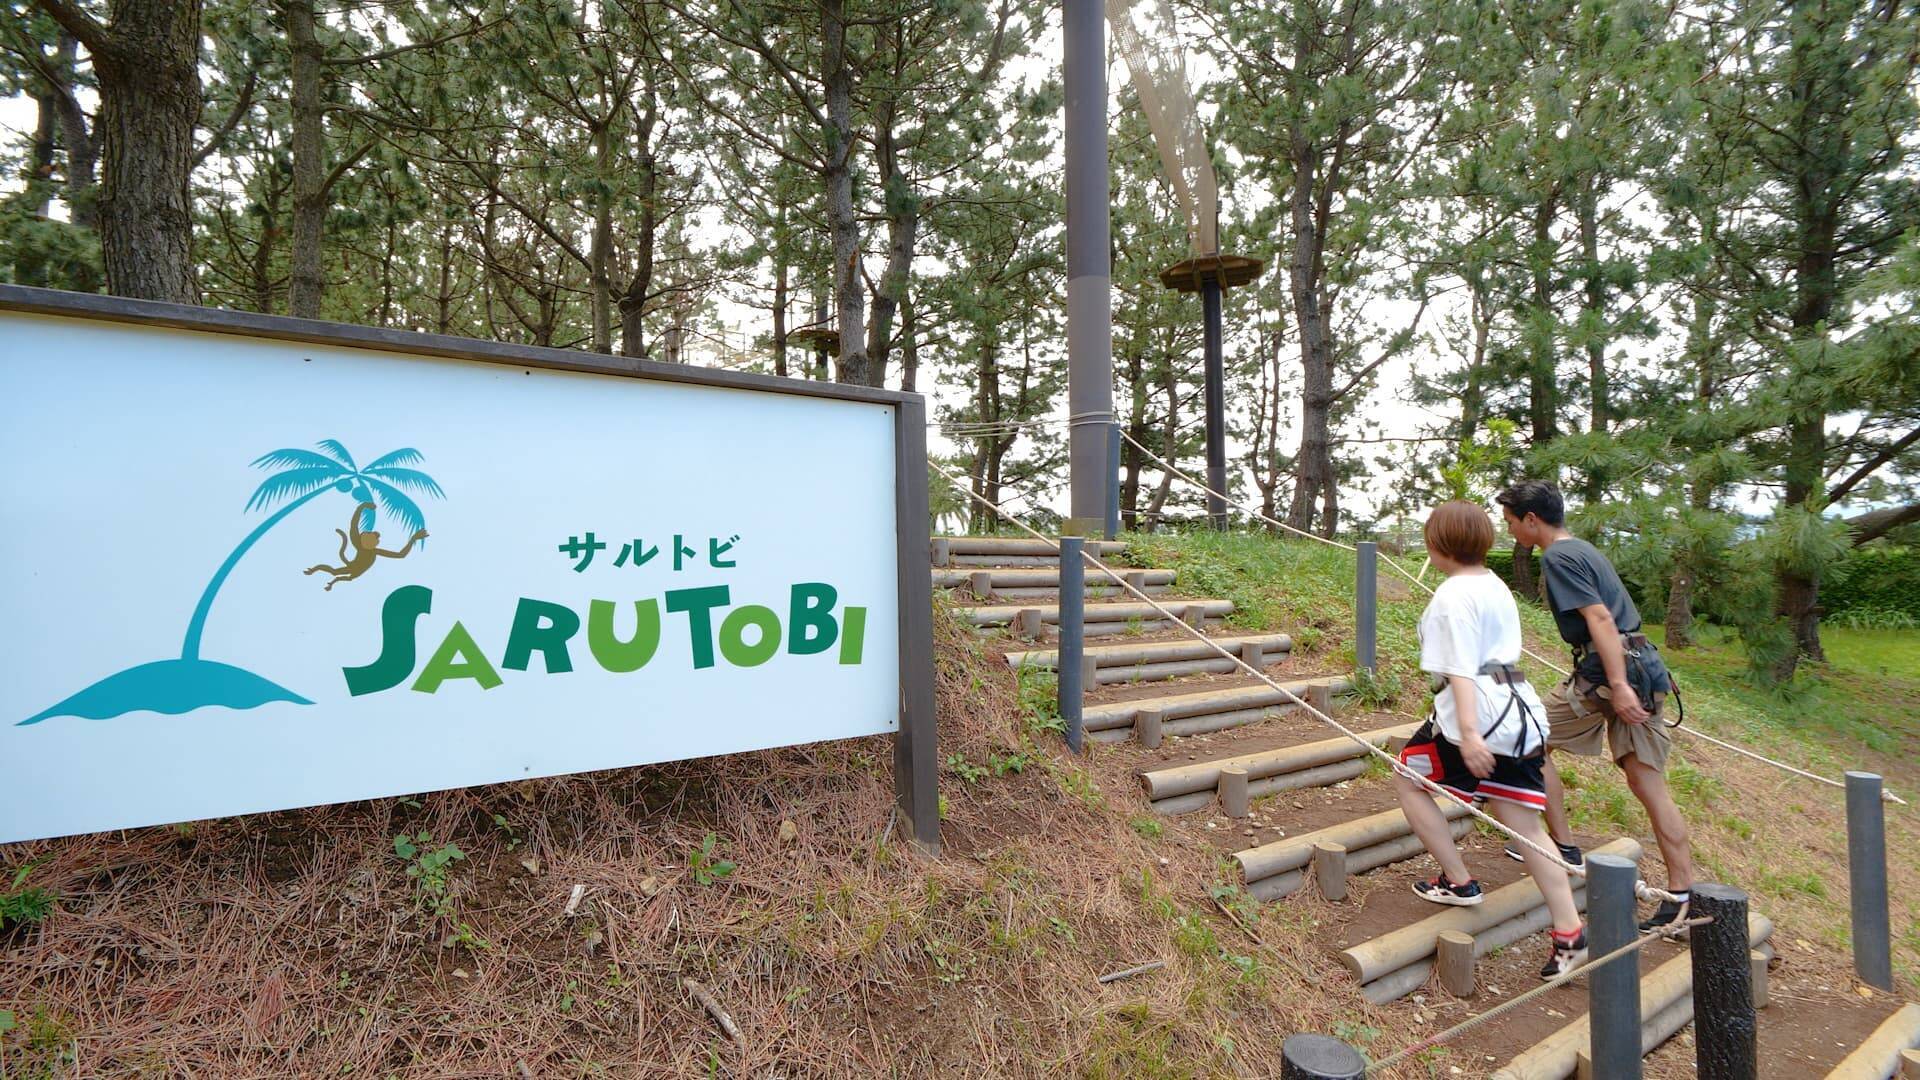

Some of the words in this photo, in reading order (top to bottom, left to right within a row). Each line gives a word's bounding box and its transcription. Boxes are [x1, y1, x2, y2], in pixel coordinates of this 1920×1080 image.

[558, 532, 740, 573] サルトビ
[342, 582, 866, 697] SARUTOBI
